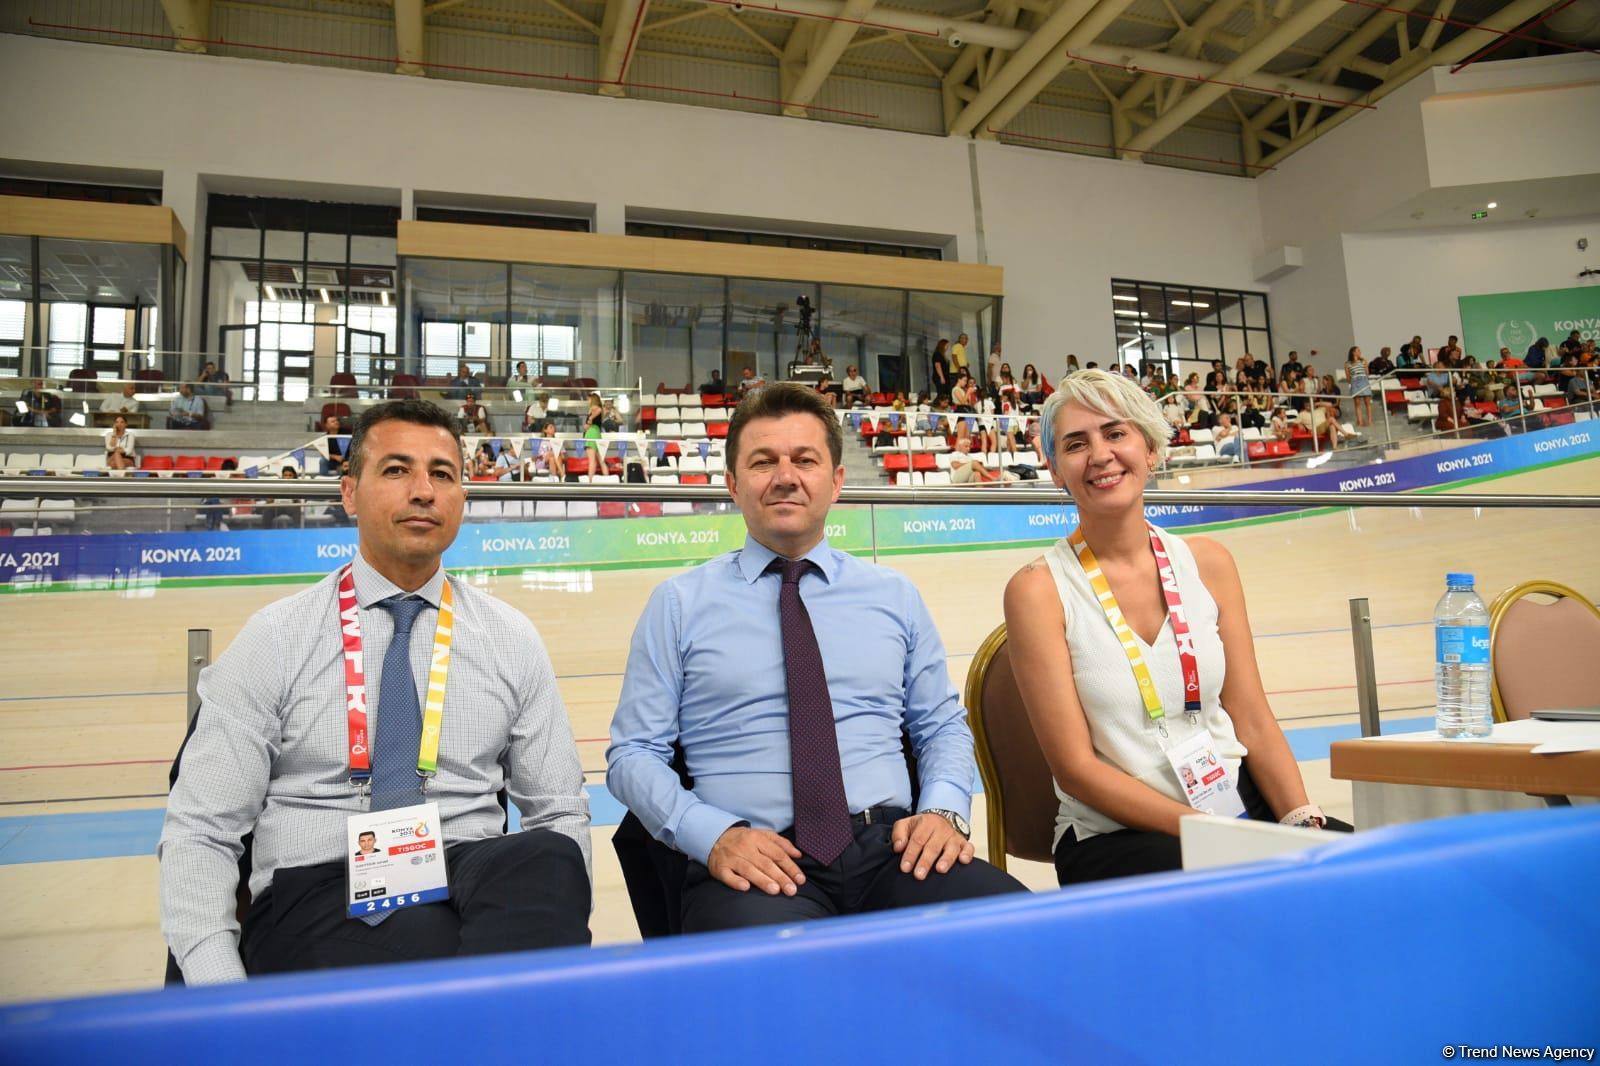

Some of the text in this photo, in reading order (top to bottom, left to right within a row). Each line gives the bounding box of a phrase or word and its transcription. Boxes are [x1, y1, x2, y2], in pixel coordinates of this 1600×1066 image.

[1534, 433, 1591, 453] KONYA 2021
[1437, 453, 1493, 473] KONYA 2021
[1339, 473, 1396, 492] KONYA 2021
[904, 518, 976, 533] KONYA 2021
[1028, 513, 1069, 526] KONYA
[482, 536, 570, 552] KONYA 2021
[636, 530, 719, 546] KONYA 2021
[21, 552, 60, 566] 2021
[141, 547, 241, 564] KONYA 2021
[367, 893, 420, 911] 2 4 5 6
